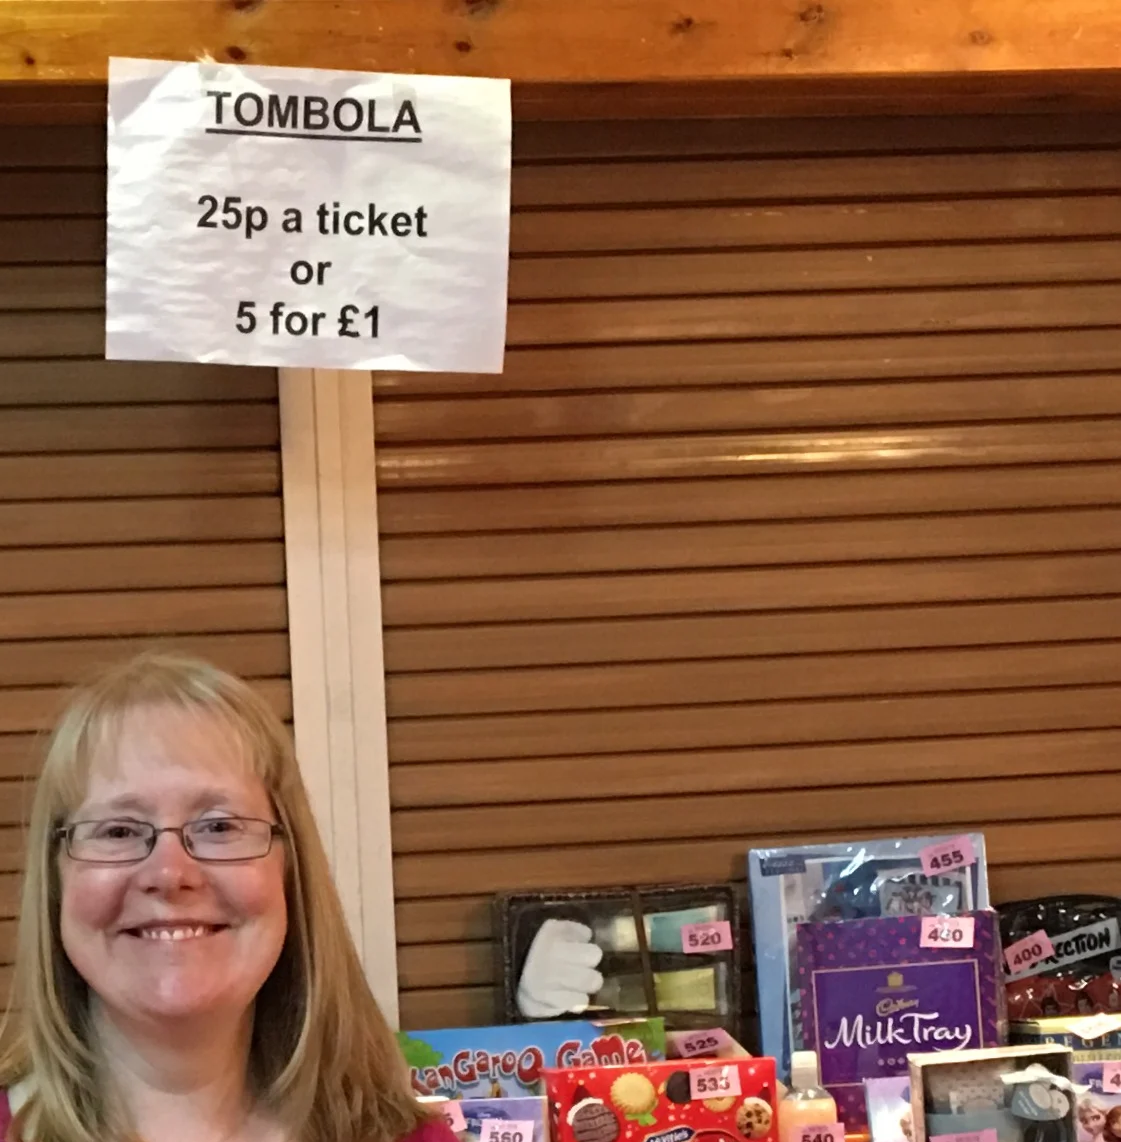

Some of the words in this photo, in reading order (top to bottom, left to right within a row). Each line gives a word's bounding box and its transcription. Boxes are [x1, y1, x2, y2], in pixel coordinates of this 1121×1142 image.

[206, 90, 421, 134] TOMBOLA
[196, 194, 269, 239] 25p
[281, 208, 303, 235] a
[316, 201, 429, 239] ticket
[289, 259, 332, 287] or
[235, 301, 257, 334] 5
[269, 301, 327, 337] for
[337, 304, 380, 339] £1
[930, 849, 964, 870] 455
[688, 931, 722, 947] 520
[1013, 943, 1043, 966] 400
[684, 1035, 719, 1054] 525
[824, 1013, 908, 1050] Milk
[898, 1011, 973, 1053] Tray
